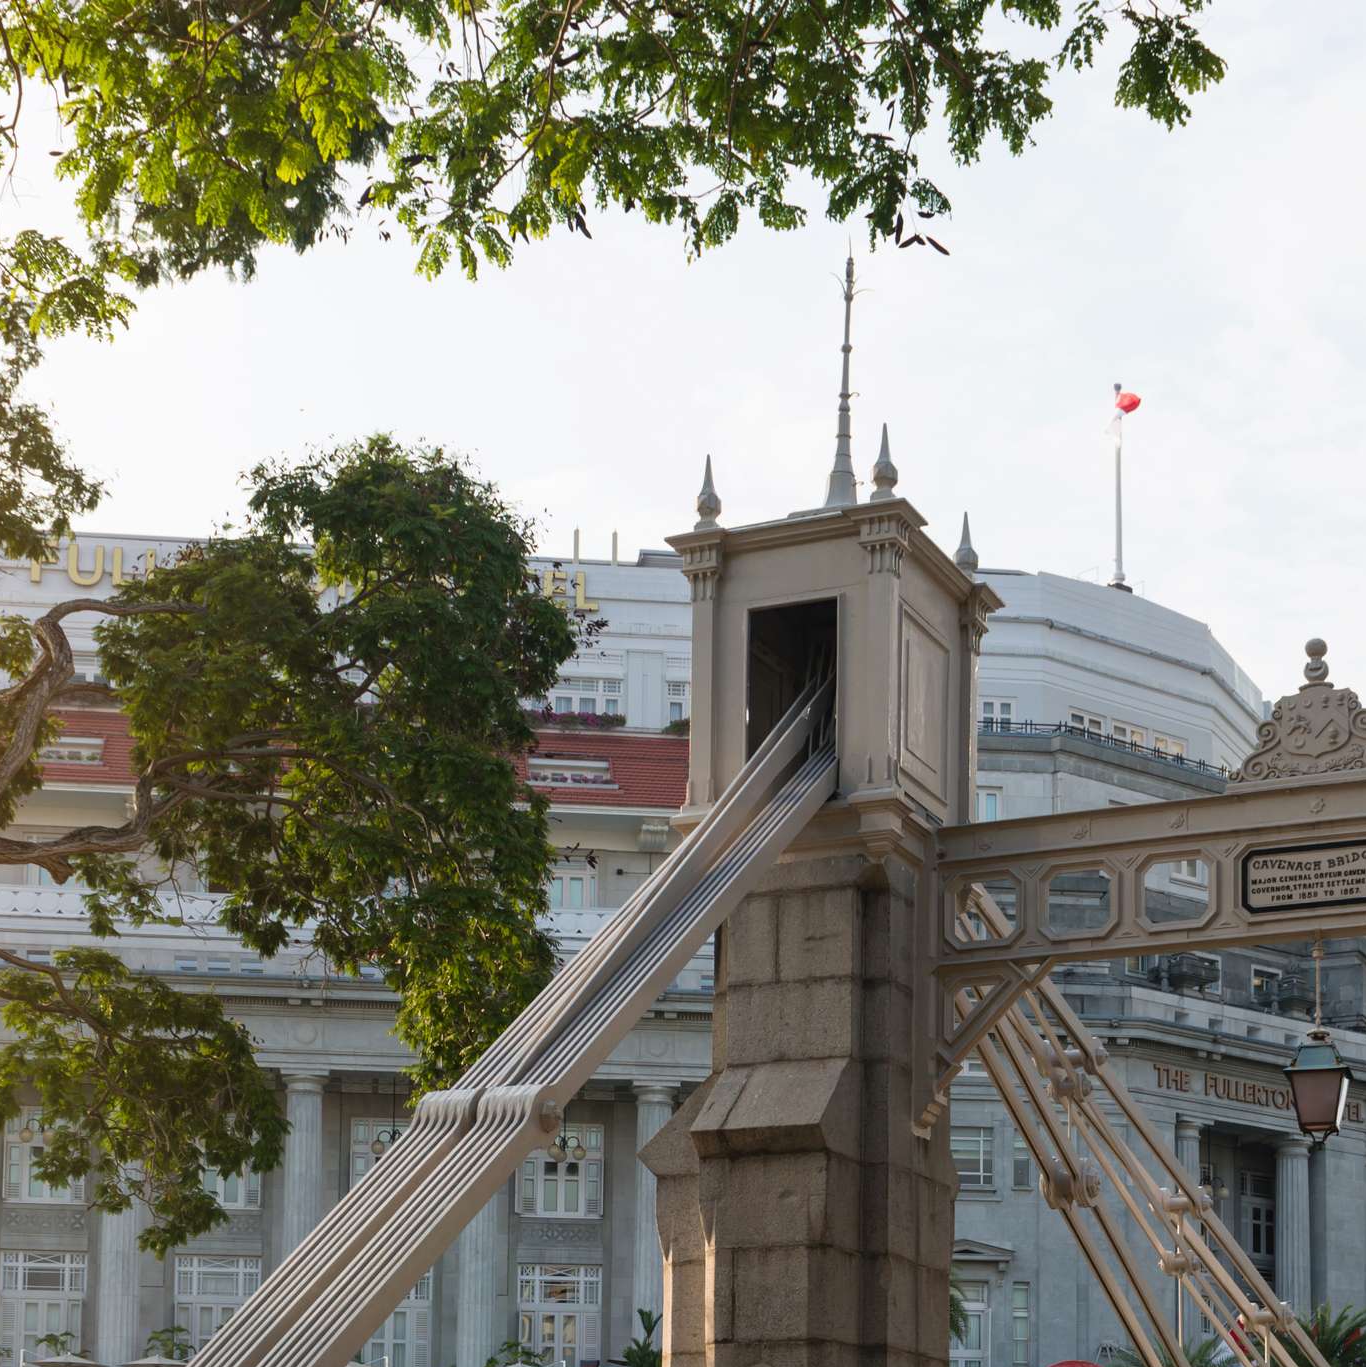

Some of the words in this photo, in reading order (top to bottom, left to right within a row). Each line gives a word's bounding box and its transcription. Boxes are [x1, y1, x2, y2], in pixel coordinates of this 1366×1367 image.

[1252, 859, 1322, 871] CAVENAGH
[1251, 876, 1277, 885] MAJOR
[1279, 873, 1312, 882] GENERAL
[1271, 893, 1293, 901] FROM
[1324, 889, 1335, 897] TO
[1154, 1063, 1190, 1093] THE
